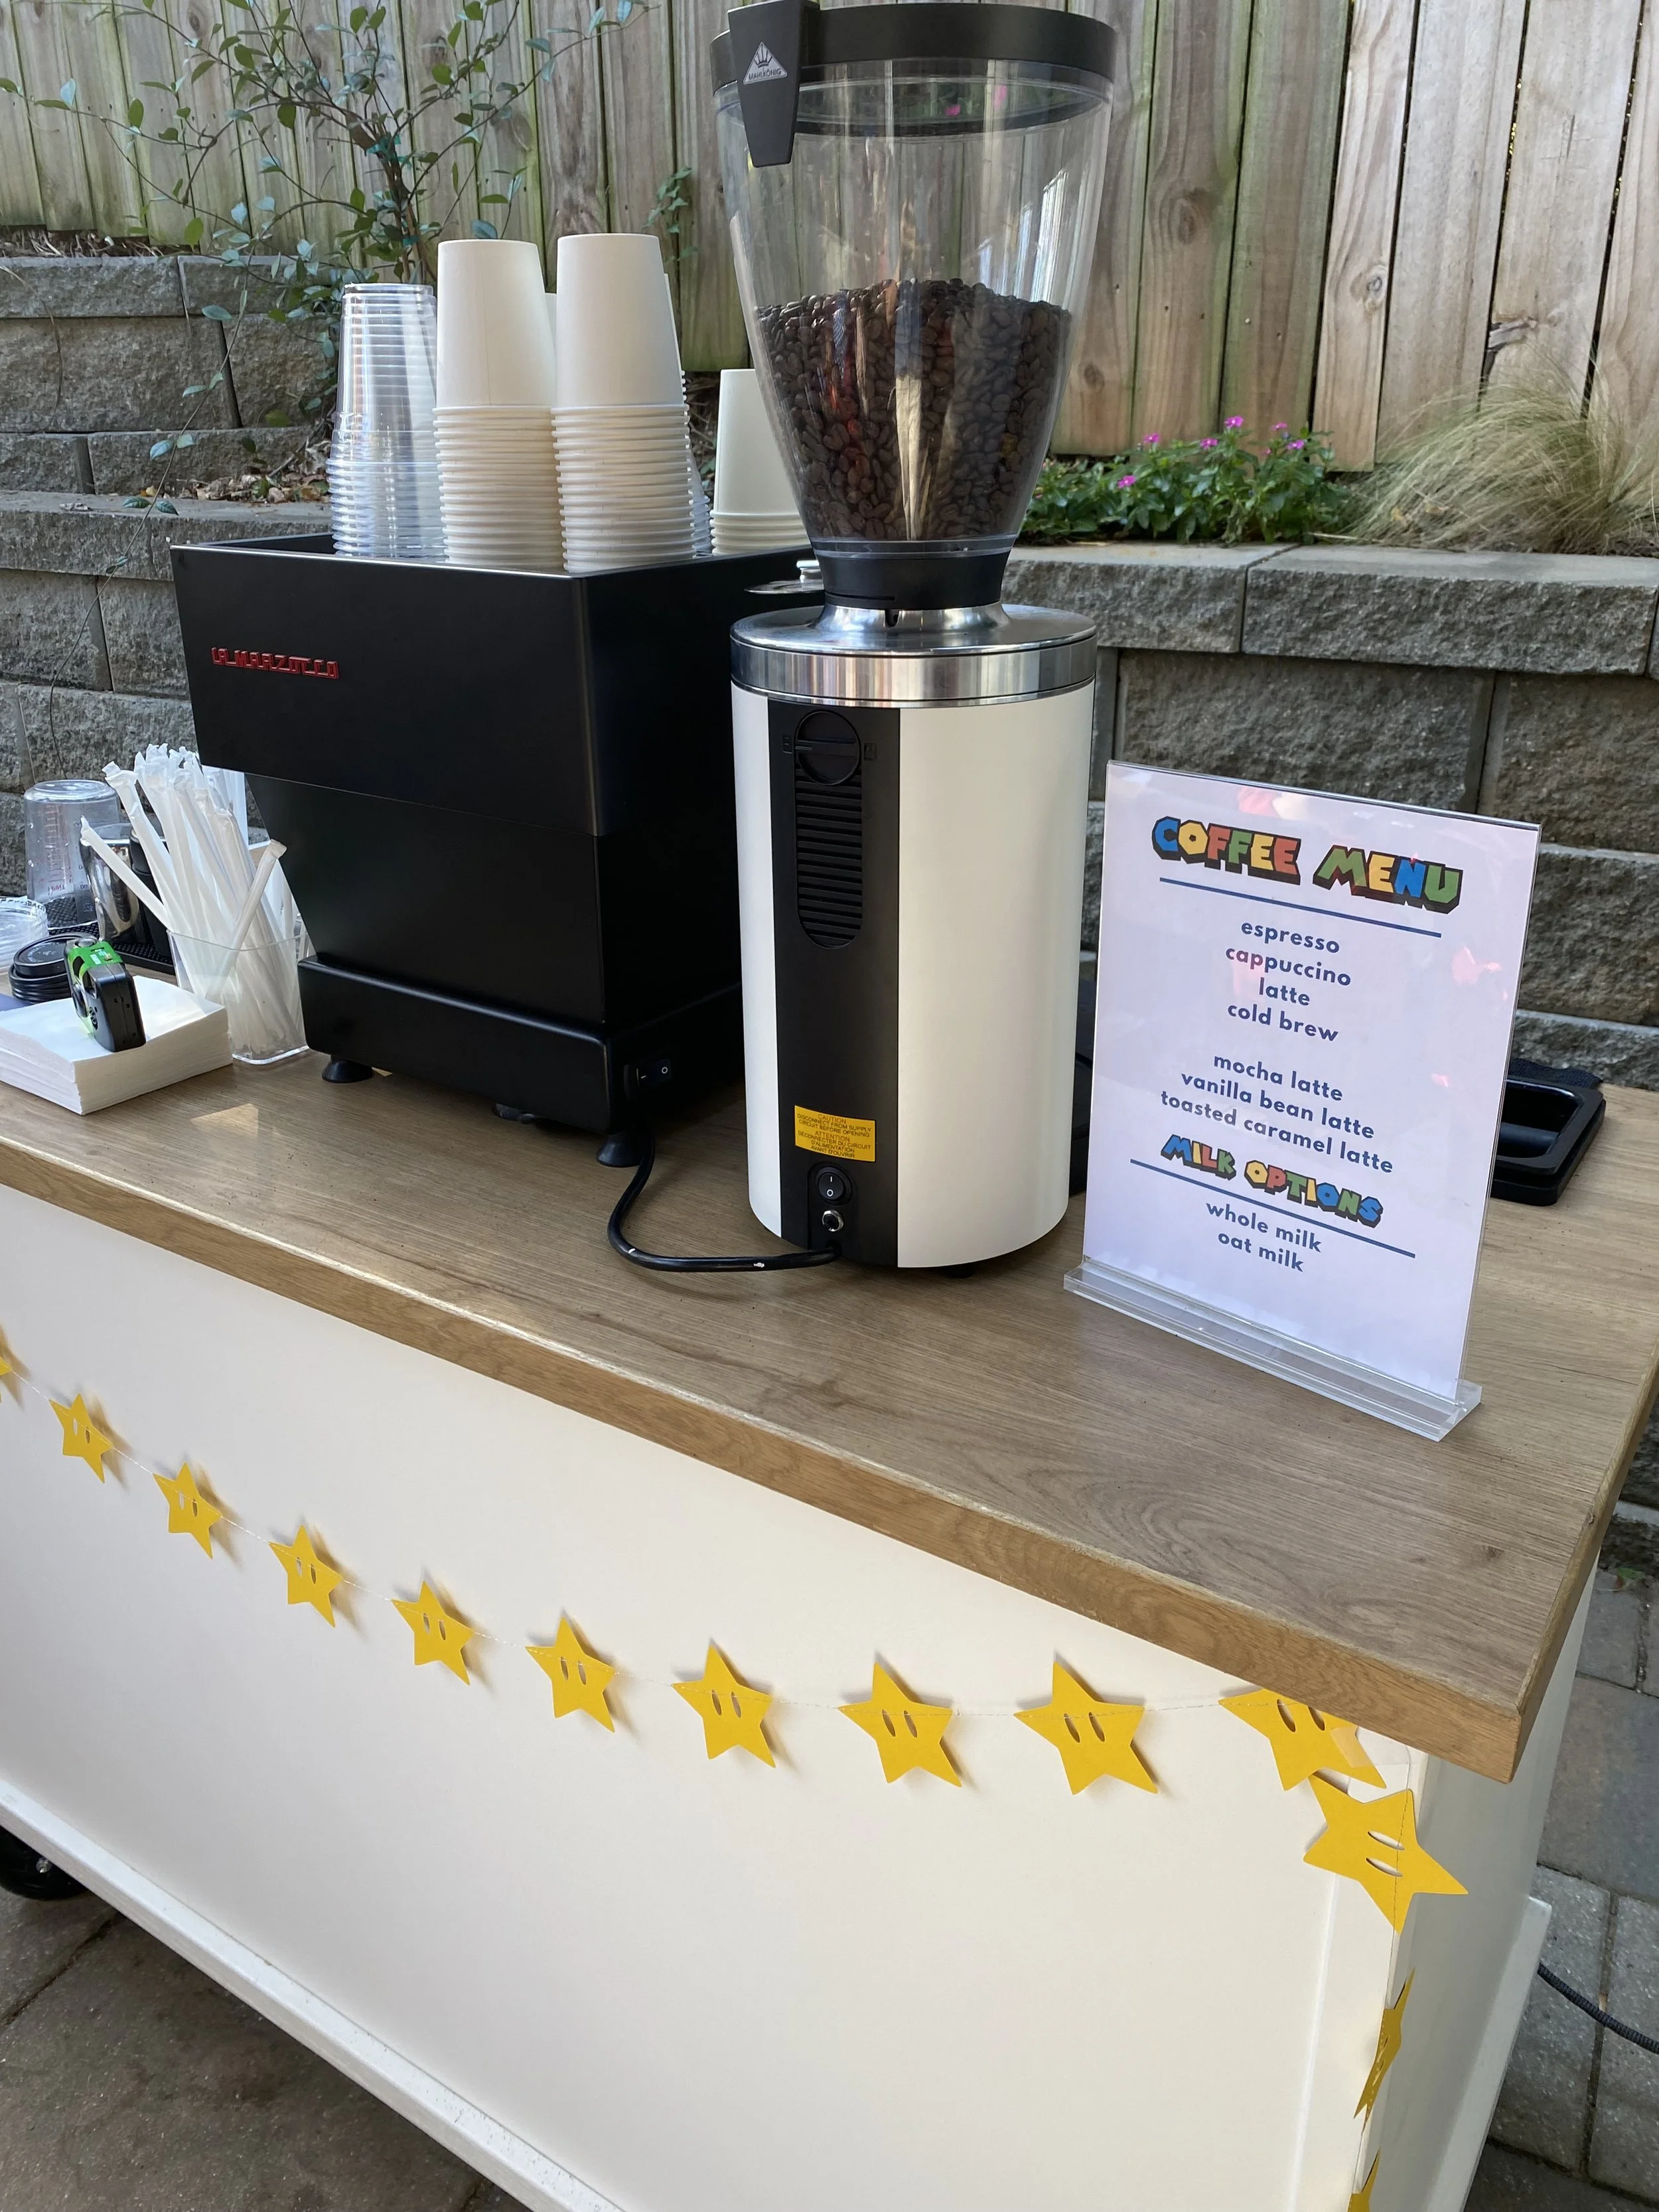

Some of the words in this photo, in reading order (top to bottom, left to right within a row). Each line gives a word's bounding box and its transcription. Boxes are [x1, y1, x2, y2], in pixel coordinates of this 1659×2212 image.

[1151, 816, 1301, 885] COFFEE
[1312, 844, 1464, 915] MENU
[1241, 921, 1340, 954] espresso
[1225, 947, 1352, 987] cappuccino
[1259, 976, 1311, 1007] latte
[1227, 1003, 1272, 1026] cold
[1279, 1010, 1339, 1042] brew
[1214, 1055, 1284, 1086] mocha
[1291, 1070, 1343, 1102] latte
[797, 1113, 830, 1125] DISCONNECT
[818, 1114, 847, 1124] CAUTION
[1181, 1073, 1252, 1104] vanilla
[1260, 1089, 1314, 1123] bean
[1321, 1106, 1374, 1140] latte
[799, 1120, 818, 1128] CIRCUIT
[820, 1124, 841, 1134] BEFORE
[843, 1129, 870, 1138] OPENING
[811, 1140, 855, 1153] D'ALIMENTATION
[815, 1130, 850, 1142] ATTENTION
[1161, 1090, 1237, 1126] toasted
[1243, 1118, 1333, 1156] caramel
[1339, 1140, 1394, 1174] latte
[828, 1148, 855, 1158] D'OUVRIR
[1160, 1134, 1236, 1180] MILK
[1244, 1159, 1384, 1228] OPTIONS
[1205, 1202, 1269, 1234] whole
[1275, 1226, 1322, 1253] milk
[1218, 1232, 1252, 1254] oat
[1258, 1246, 1304, 1273] milk
